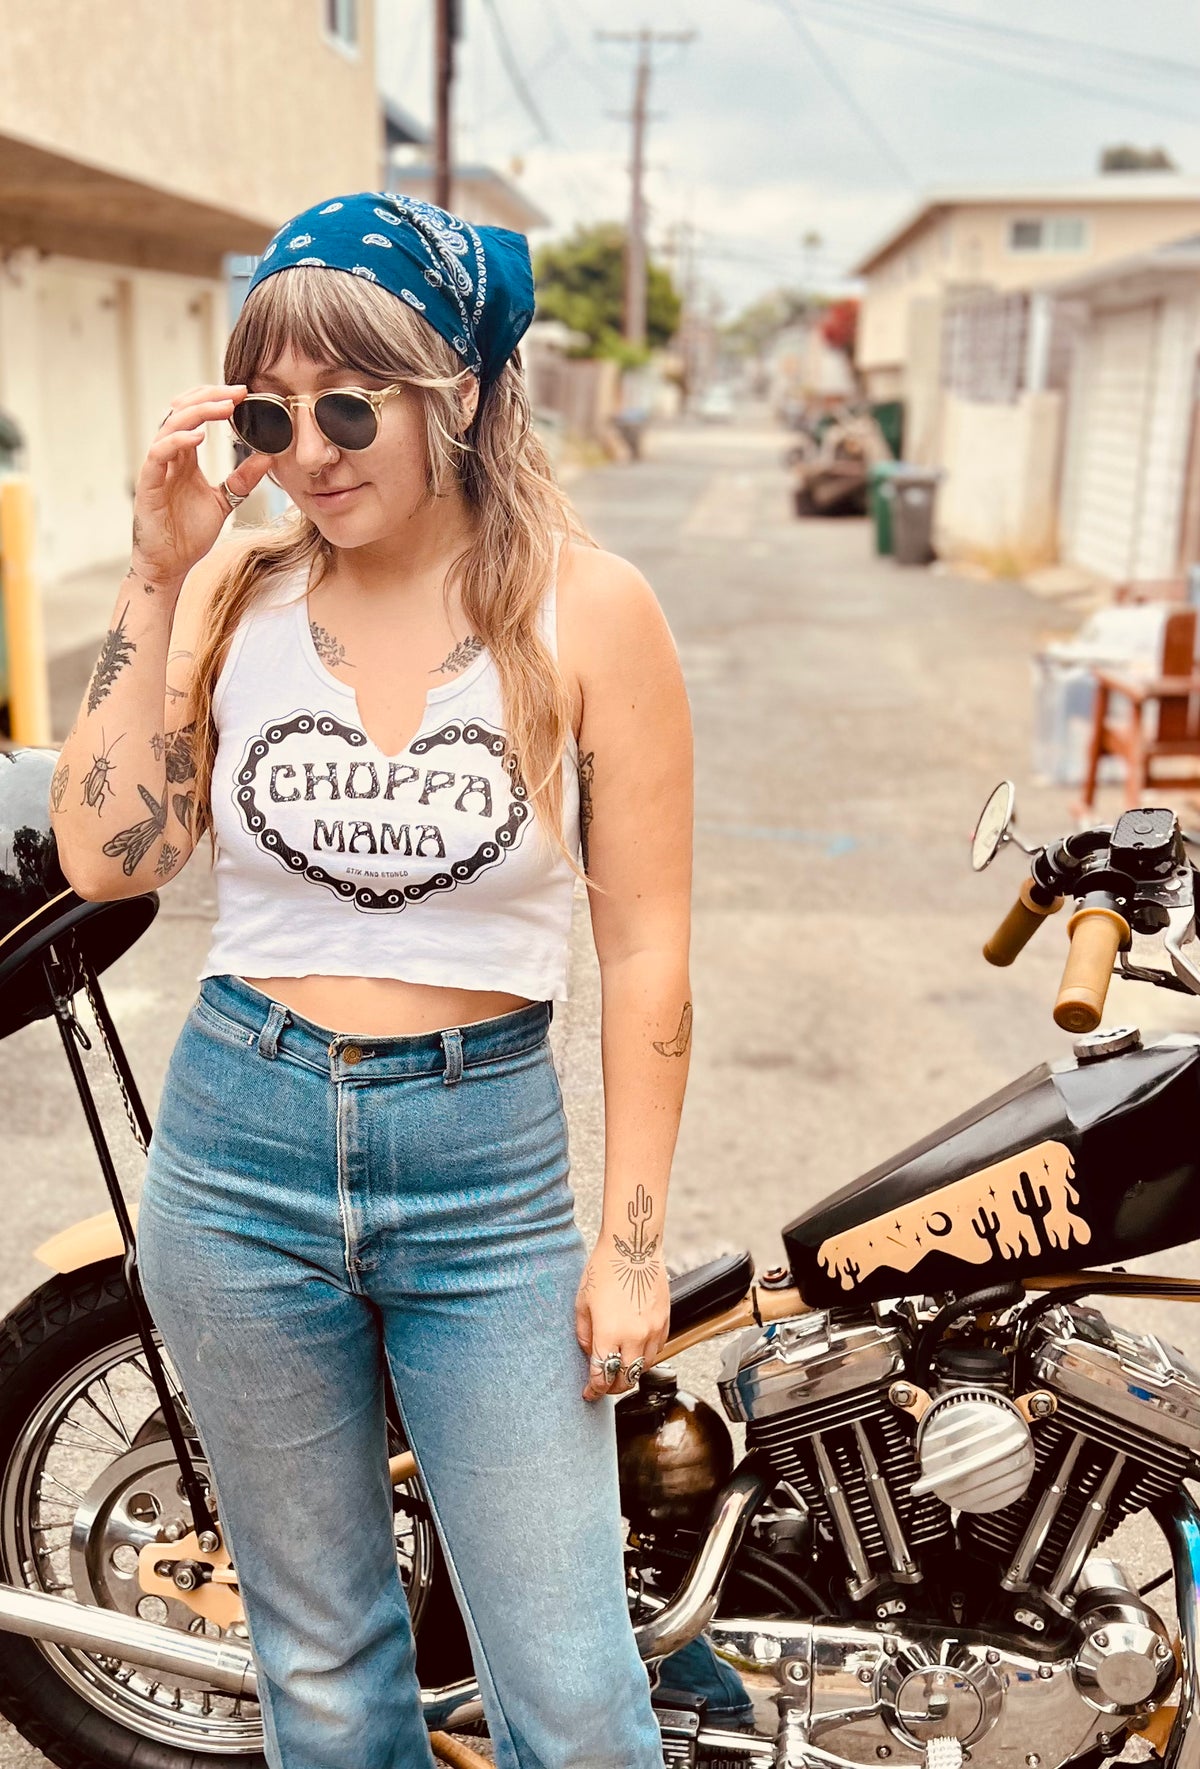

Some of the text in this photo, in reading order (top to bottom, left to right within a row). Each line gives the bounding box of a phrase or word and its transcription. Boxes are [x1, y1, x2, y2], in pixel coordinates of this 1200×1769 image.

[269, 762, 493, 818] CHOPPA
[313, 819, 446, 858] MAMA
[364, 870, 379, 878] AND
